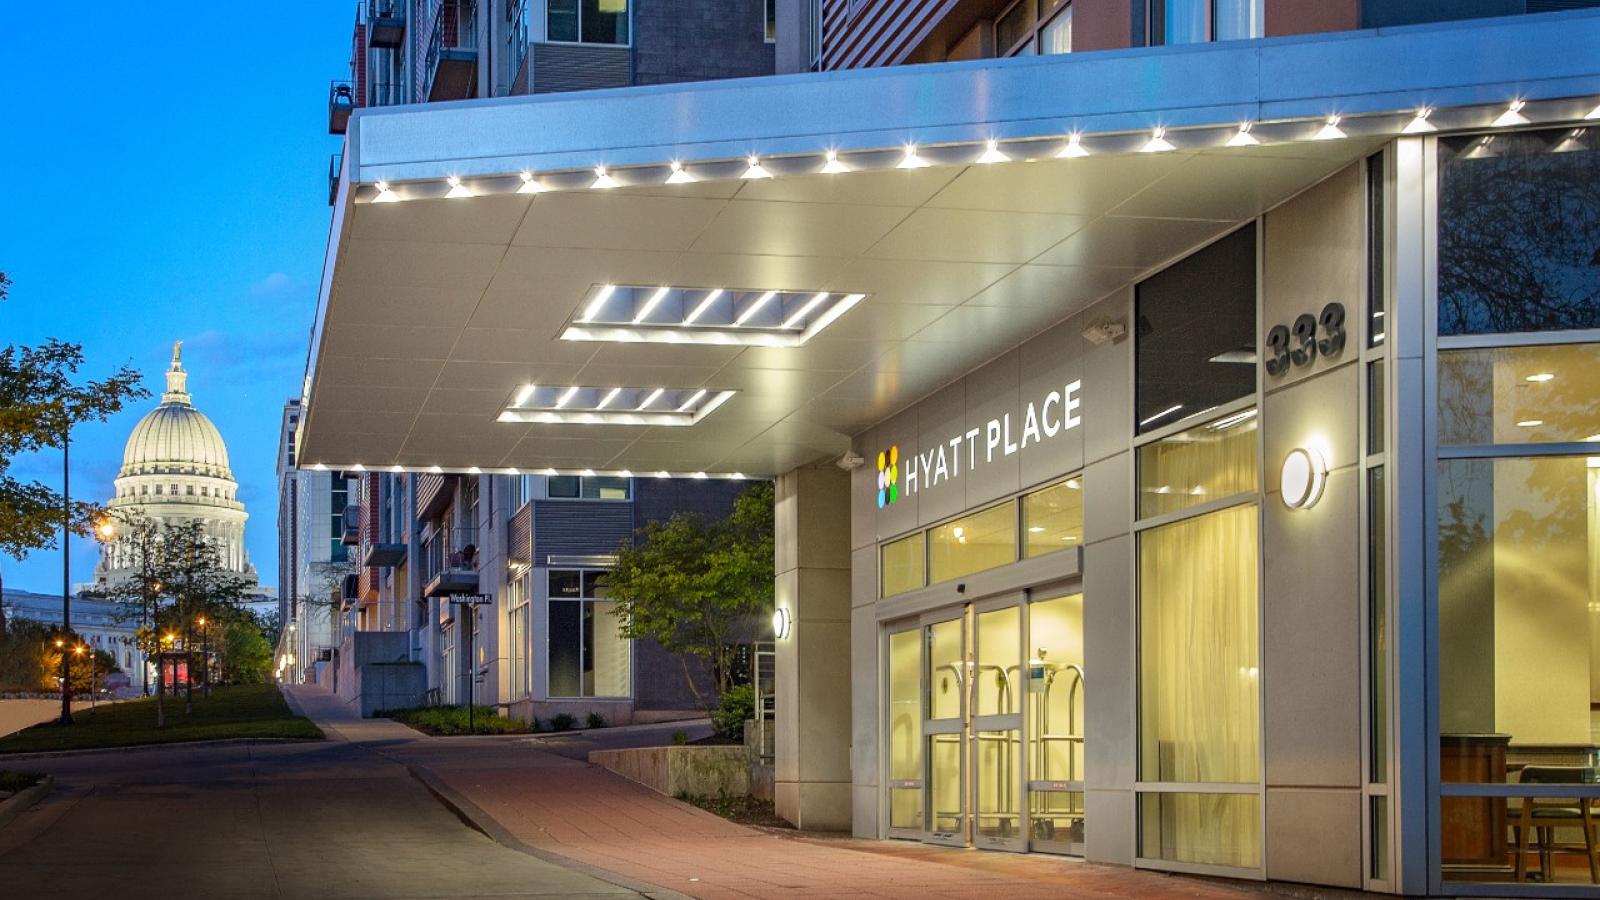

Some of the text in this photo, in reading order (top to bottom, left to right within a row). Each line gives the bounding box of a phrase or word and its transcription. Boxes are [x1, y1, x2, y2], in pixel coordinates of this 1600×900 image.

[1266, 302, 1346, 377] 333
[905, 379, 1081, 497] HYATT PLACE
[450, 593, 483, 603] Washington
